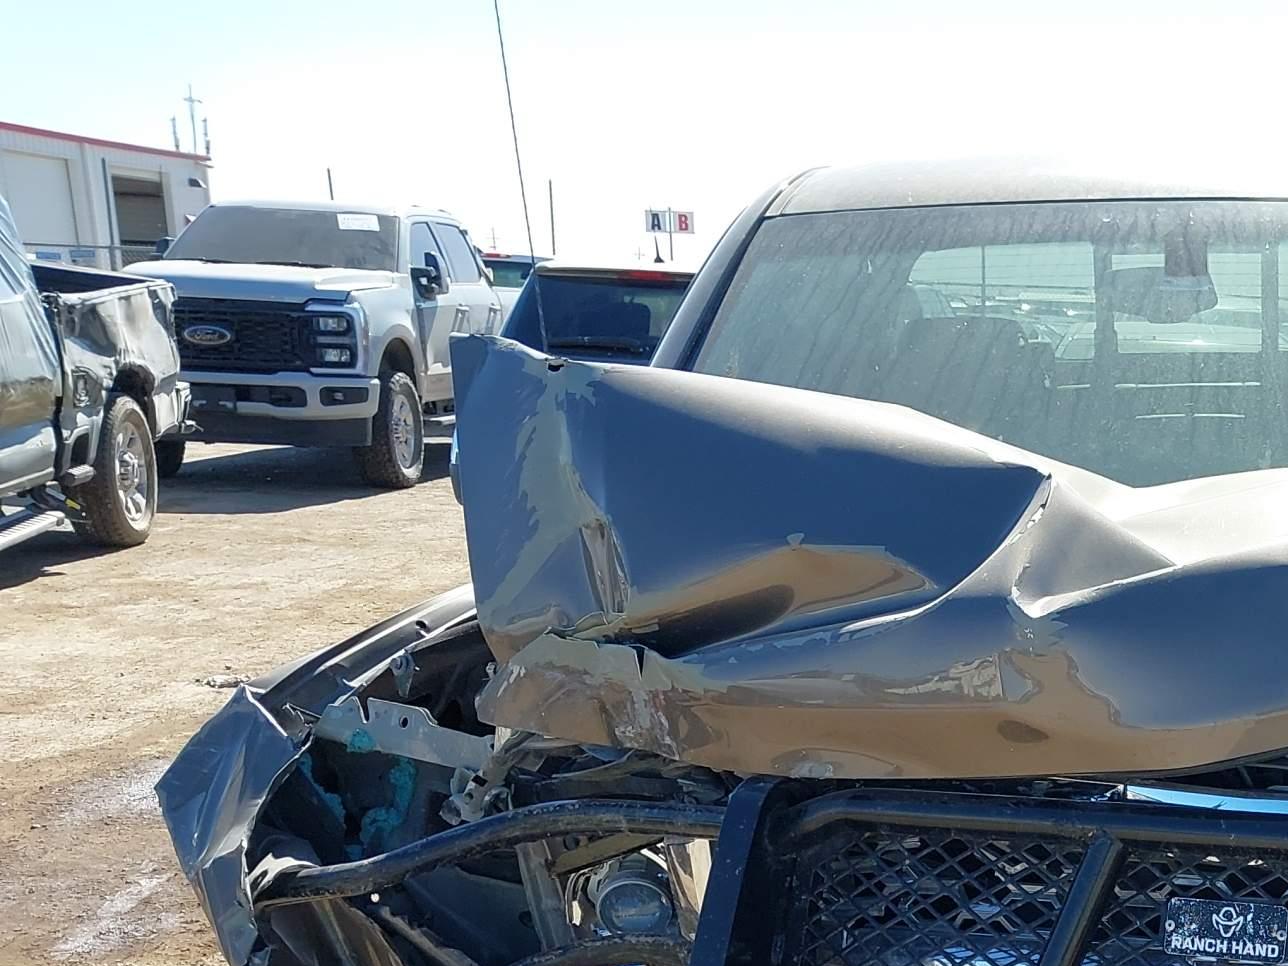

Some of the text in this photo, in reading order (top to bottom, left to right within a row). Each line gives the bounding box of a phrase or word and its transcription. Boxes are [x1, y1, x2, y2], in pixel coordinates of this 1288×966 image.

[651, 213, 689, 231] A B
[1171, 935, 1279, 958] RANCH HAND
